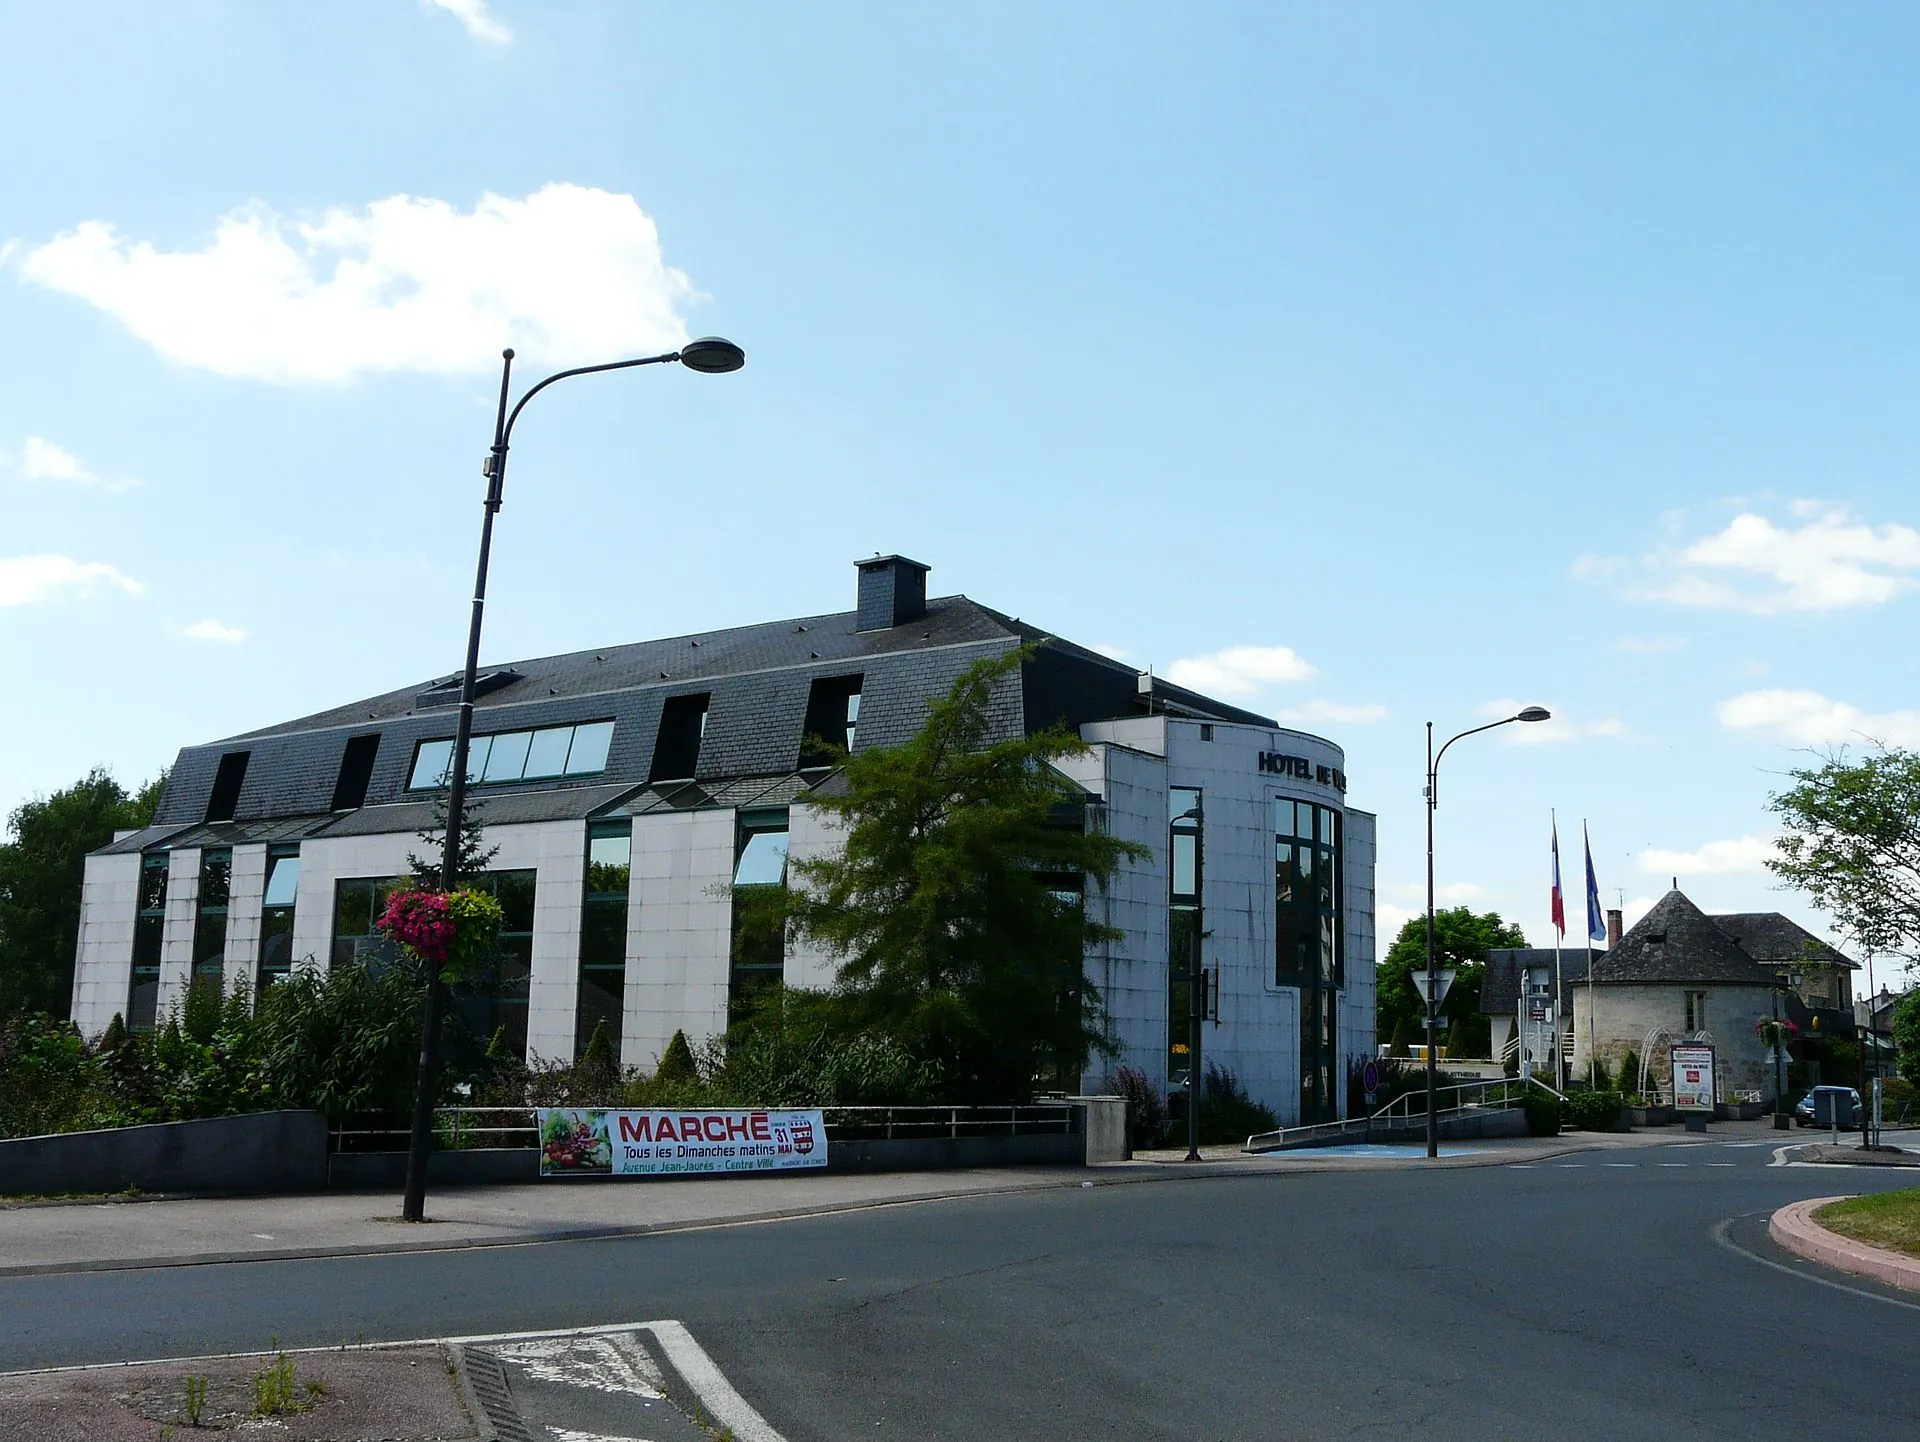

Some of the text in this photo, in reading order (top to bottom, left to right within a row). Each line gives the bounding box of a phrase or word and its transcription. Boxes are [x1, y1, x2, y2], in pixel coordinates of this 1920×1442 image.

[1258, 751, 1313, 780] HOTEL
[774, 1128, 789, 1143] 31
[624, 1143, 776, 1159] Tous les Dimanches matins
[622, 1162, 656, 1173] Avenue
[725, 1159, 754, 1170] Centre
[757, 1158, 774, 1169] Ville
